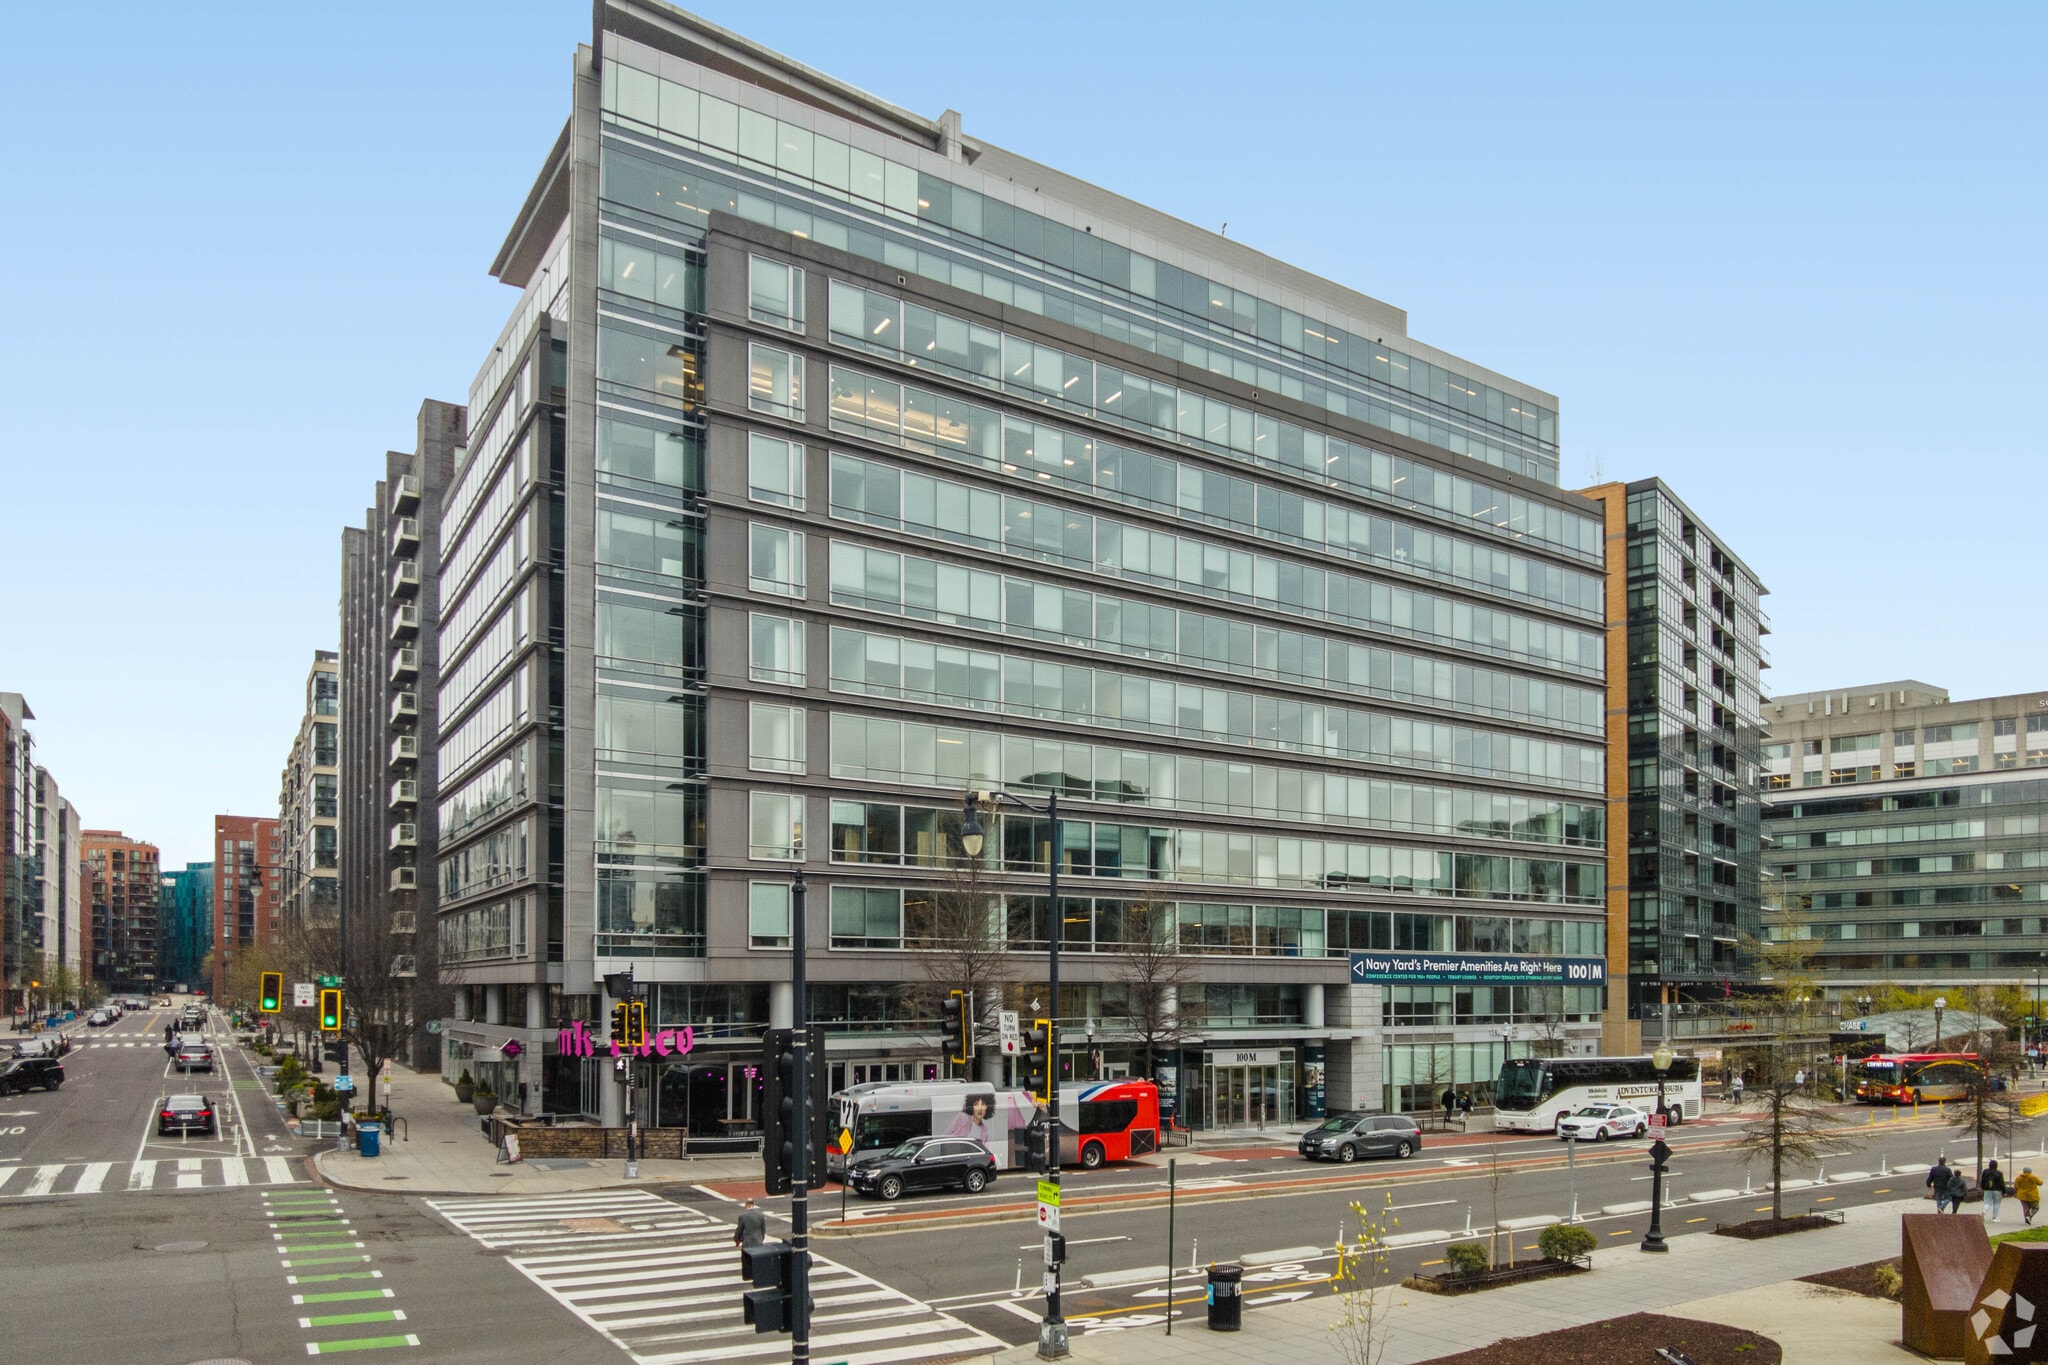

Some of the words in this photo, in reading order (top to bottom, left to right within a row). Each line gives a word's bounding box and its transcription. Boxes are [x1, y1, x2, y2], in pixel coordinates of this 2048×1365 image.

[1366, 959, 1391, 973] Navy
[1392, 959, 1421, 971] Yard's
[1424, 960, 1459, 971] Premier
[1460, 960, 1502, 972] Amenities
[1504, 961, 1518, 972] Are
[1520, 961, 1541, 974] Right
[1543, 962, 1562, 972] Here
[1004, 1014, 1014, 1023] NO
[1840, 1021, 1860, 1030] CHASE
[1009, 1033, 1018, 1041] RED
[1664, 1085, 1684, 1093] OURS
[1618, 1119, 1636, 1127] POLICE
